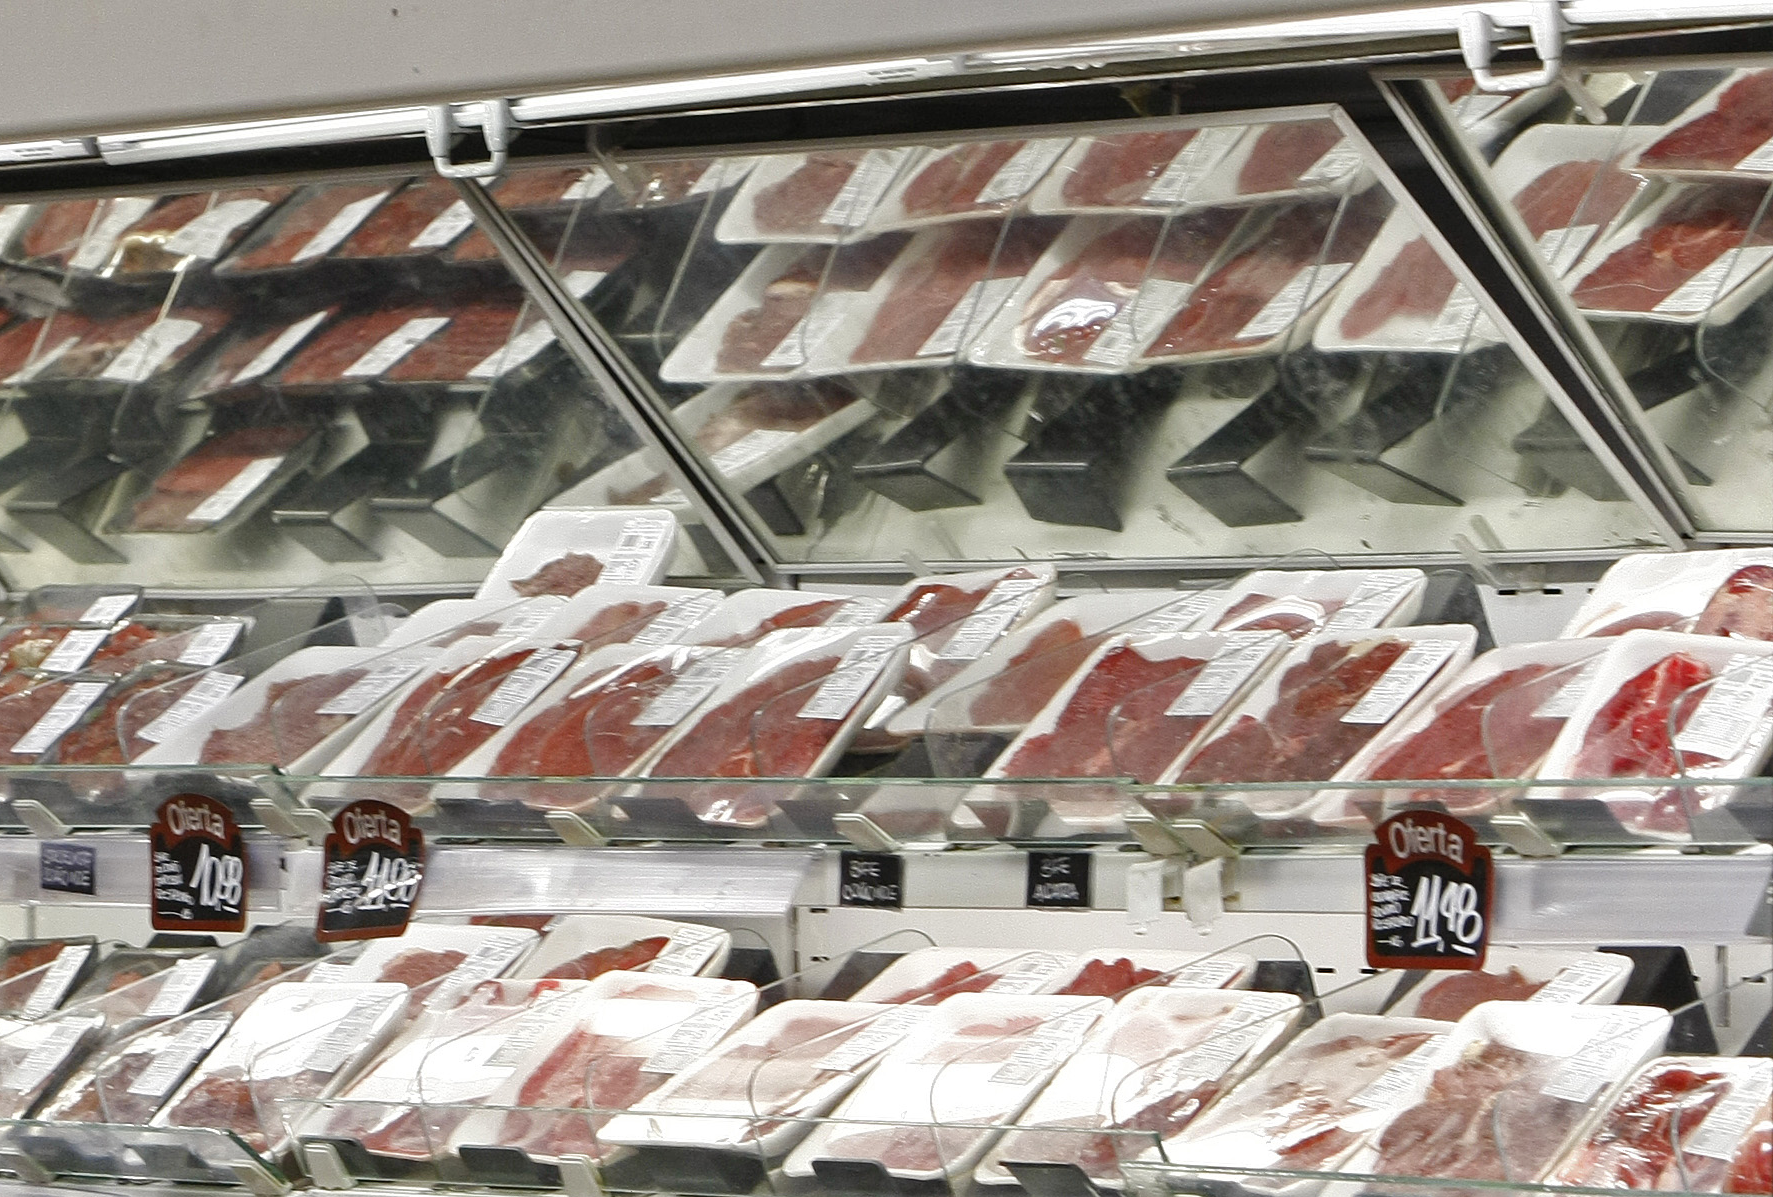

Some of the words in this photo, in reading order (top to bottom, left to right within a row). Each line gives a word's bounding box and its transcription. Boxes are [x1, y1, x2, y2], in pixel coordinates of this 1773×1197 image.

[167, 800, 226, 840] Oferta
[342, 807, 402, 847] Oferta
[1388, 818, 1464, 864] Oferta
